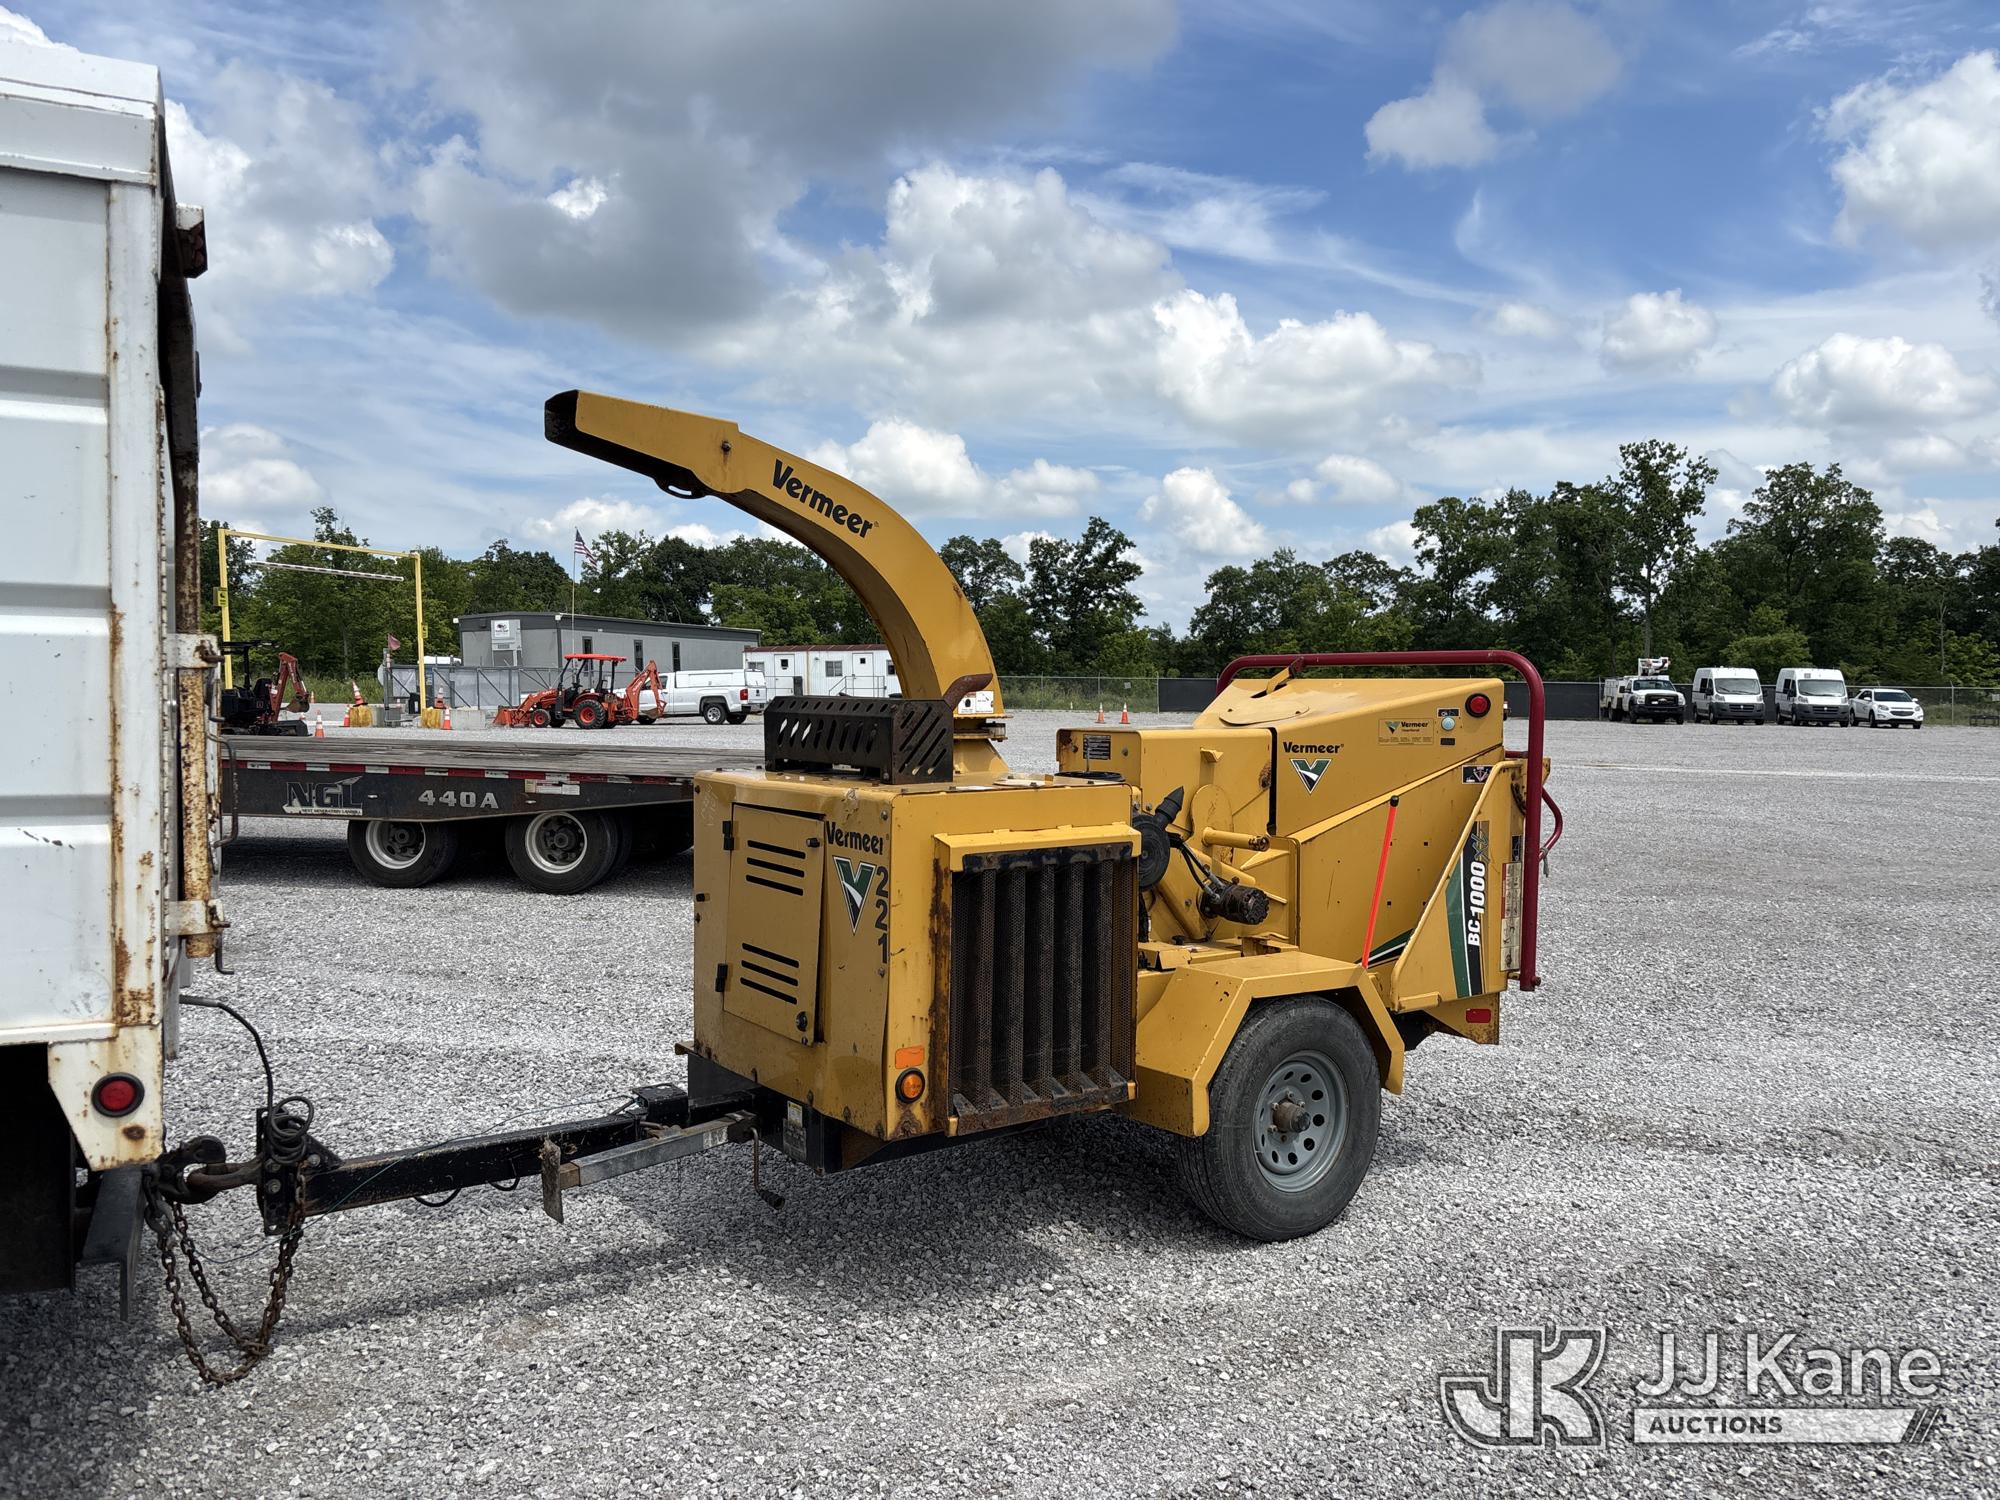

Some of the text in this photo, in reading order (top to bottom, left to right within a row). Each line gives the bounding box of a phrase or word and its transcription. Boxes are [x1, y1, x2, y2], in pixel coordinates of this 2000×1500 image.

[773, 458, 874, 539] Vermeer
[1283, 741, 1341, 754] Vermeer
[418, 789, 499, 809] 440A
